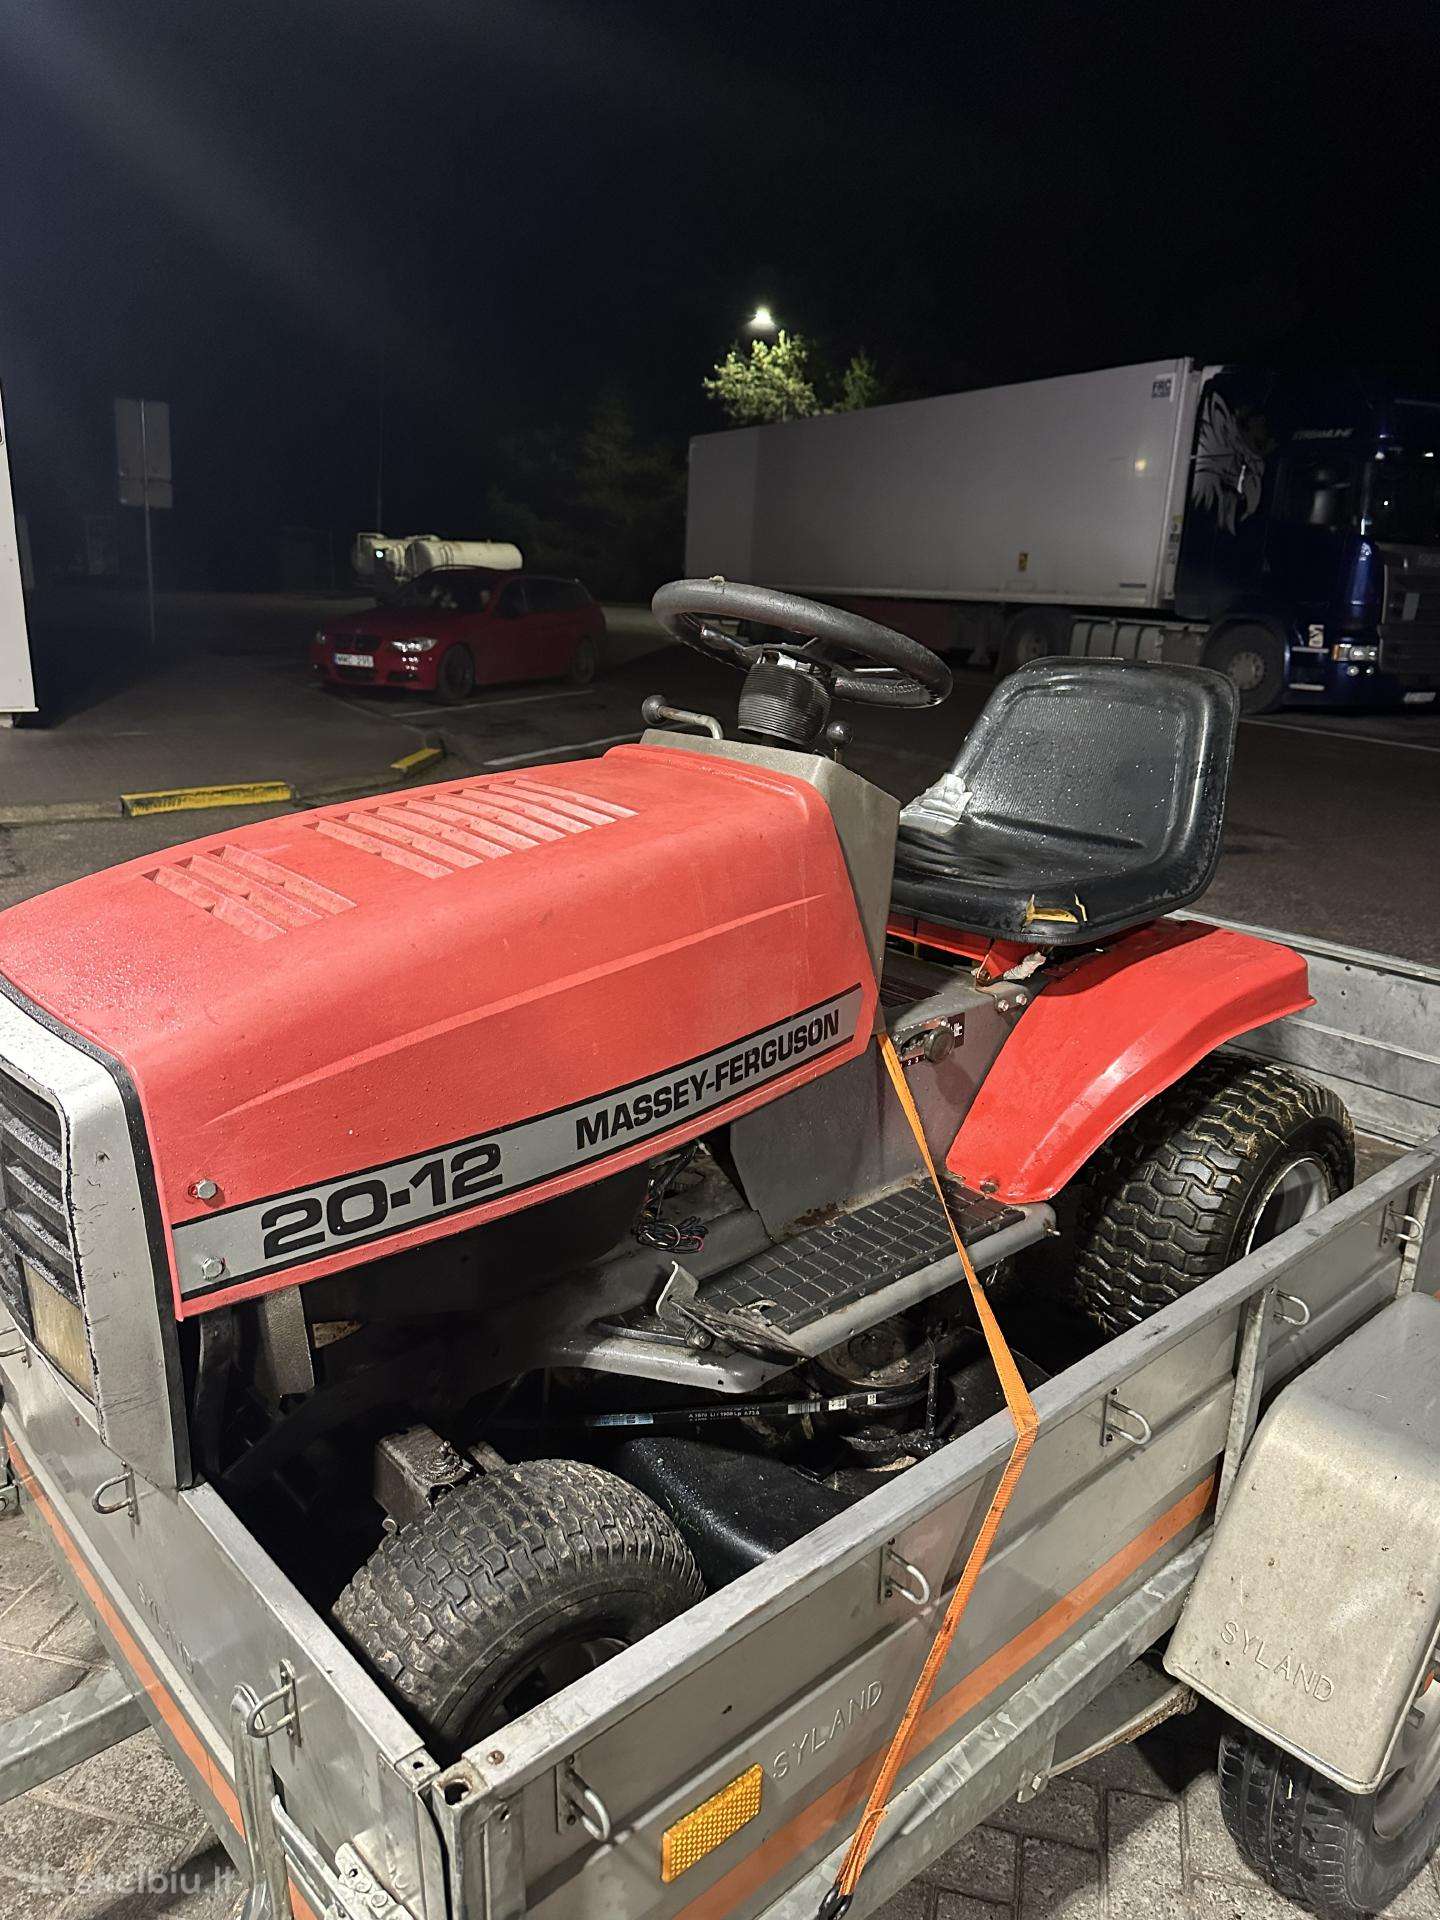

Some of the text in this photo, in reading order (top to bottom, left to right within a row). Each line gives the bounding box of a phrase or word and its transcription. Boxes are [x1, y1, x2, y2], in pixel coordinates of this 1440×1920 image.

[575, 1009, 841, 1150] MASSEY-FERGUSON
[261, 1143, 504, 1260] 20-12
[1220, 1620, 1335, 1702] SYLAND
[772, 1680, 883, 1779] SYLAND
